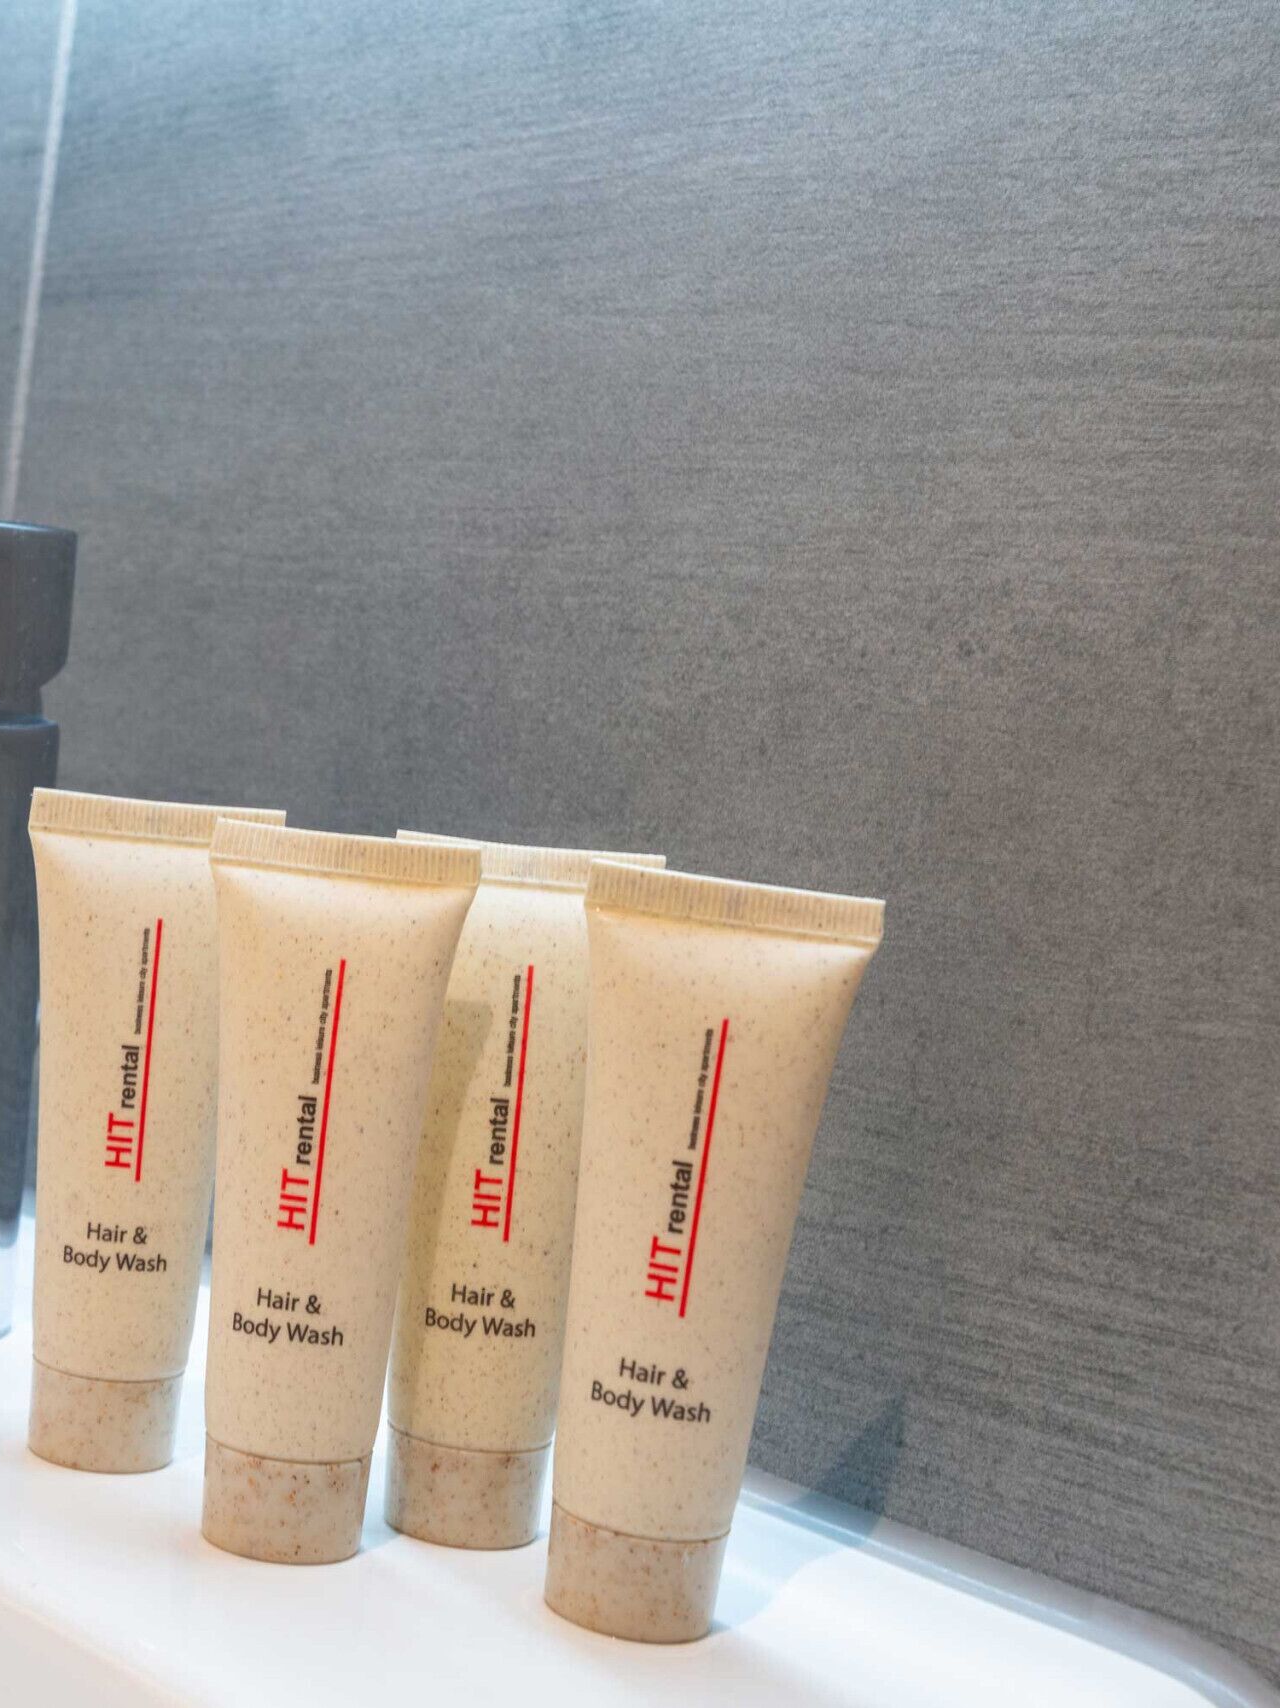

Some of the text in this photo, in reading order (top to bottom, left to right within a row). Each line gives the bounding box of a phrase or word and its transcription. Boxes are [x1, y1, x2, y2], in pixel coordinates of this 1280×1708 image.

[105, 1113, 134, 1168] HIT
[120, 1045, 139, 1109] rental
[277, 1168, 309, 1230] HIT
[294, 1096, 317, 1166] rental
[471, 1169, 502, 1228] HIT
[488, 1098, 509, 1166] rental
[86, 1222, 148, 1245] Hair &
[645, 1237, 681, 1302] HIT
[666, 1161, 693, 1234] rental
[63, 1245, 167, 1273] Body Wash
[256, 1287, 322, 1315] Hair &
[451, 1283, 516, 1309] Hair &
[232, 1312, 344, 1347] Body Wash
[425, 1308, 536, 1338] Body Wash
[619, 1357, 689, 1390] Hair &
[591, 1380, 711, 1424] Body Wash
